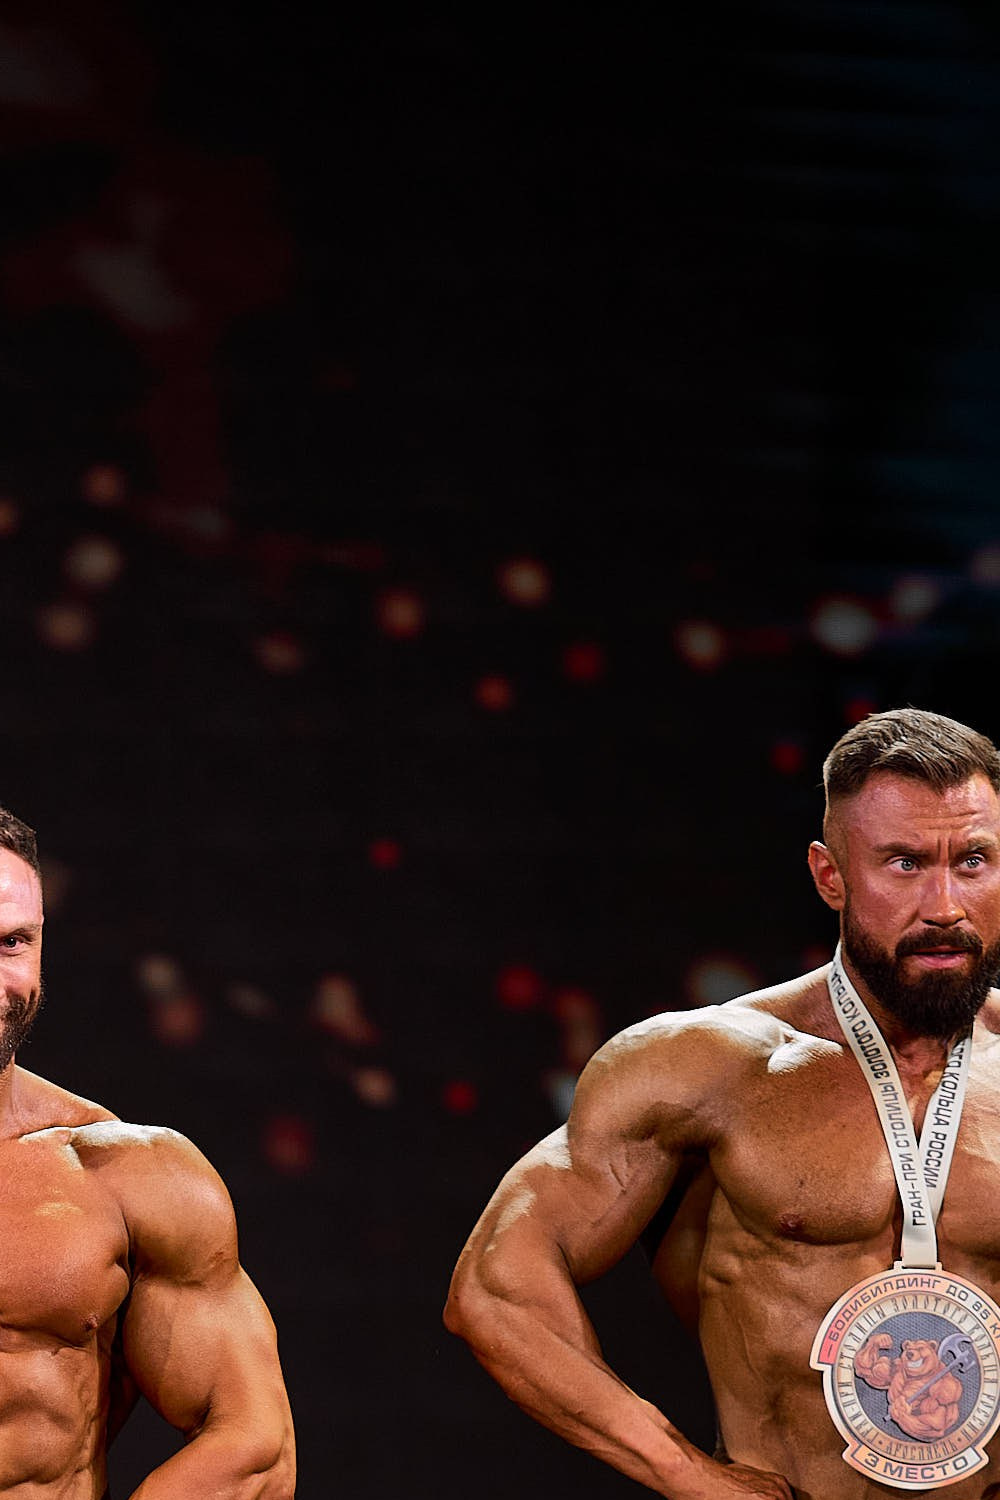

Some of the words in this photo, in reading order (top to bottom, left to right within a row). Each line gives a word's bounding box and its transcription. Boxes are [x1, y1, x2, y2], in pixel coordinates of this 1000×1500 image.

[851, 1019, 890, 1079] ЗОЛОТОГО
[878, 1081, 909, 1149] СТОЛИЦЫ
[932, 1071, 960, 1126] КОЛЬЦА
[898, 1153, 926, 1227] ГРАН-ПРИ
[924, 1132, 947, 1188] РОССИИ
[829, 1277, 942, 1342] БОДИБИЛДИНГ
[946, 1284, 969, 1302] ДО
[972, 1300, 991, 1320] 85
[864, 1453, 879, 1468] 3
[882, 1455, 969, 1480] МЕСТО
